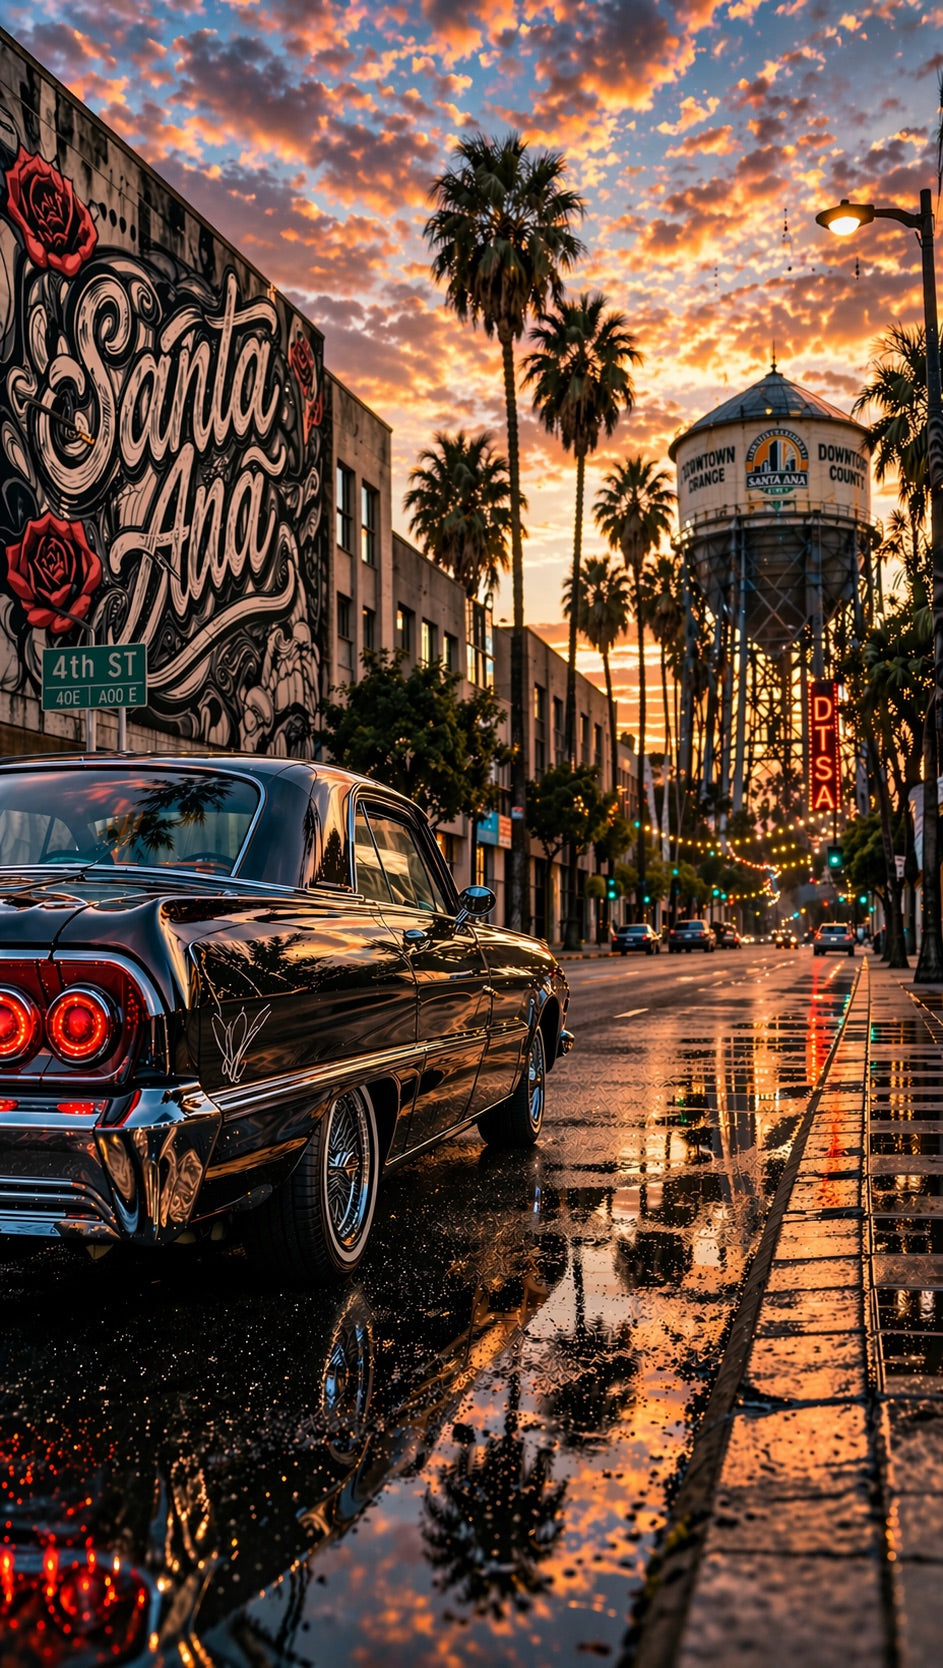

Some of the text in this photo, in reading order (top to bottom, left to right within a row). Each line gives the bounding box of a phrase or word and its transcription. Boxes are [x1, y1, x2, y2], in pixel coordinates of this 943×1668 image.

[39, 271, 280, 496] Santa
[748, 474, 806, 487] SANTA ANA
[52, 651, 137, 679] 4th ST
[56, 690, 80, 705] 40E
[129, 687, 137, 703] E
[813, 696, 834, 809] DTSA
